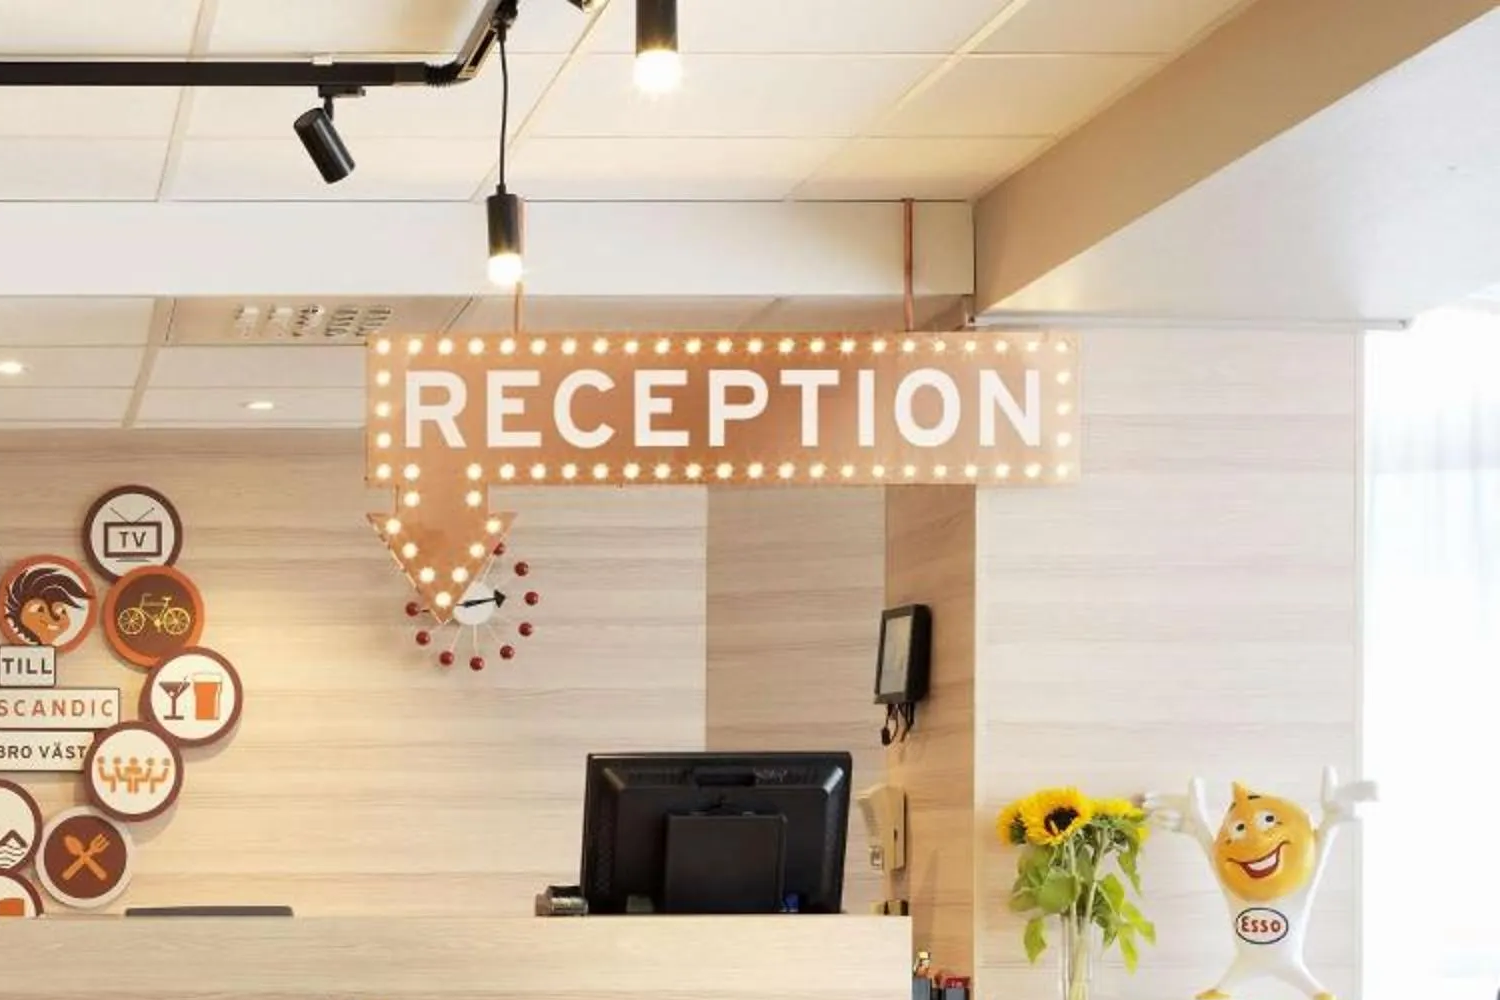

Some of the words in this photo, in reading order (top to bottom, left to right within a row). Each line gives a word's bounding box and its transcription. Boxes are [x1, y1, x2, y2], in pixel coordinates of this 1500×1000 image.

[404, 368, 1041, 448] RECEPTION
[118, 531, 147, 548] TV
[2, 657, 52, 675] TILL
[39, 742, 86, 759] VÄST
